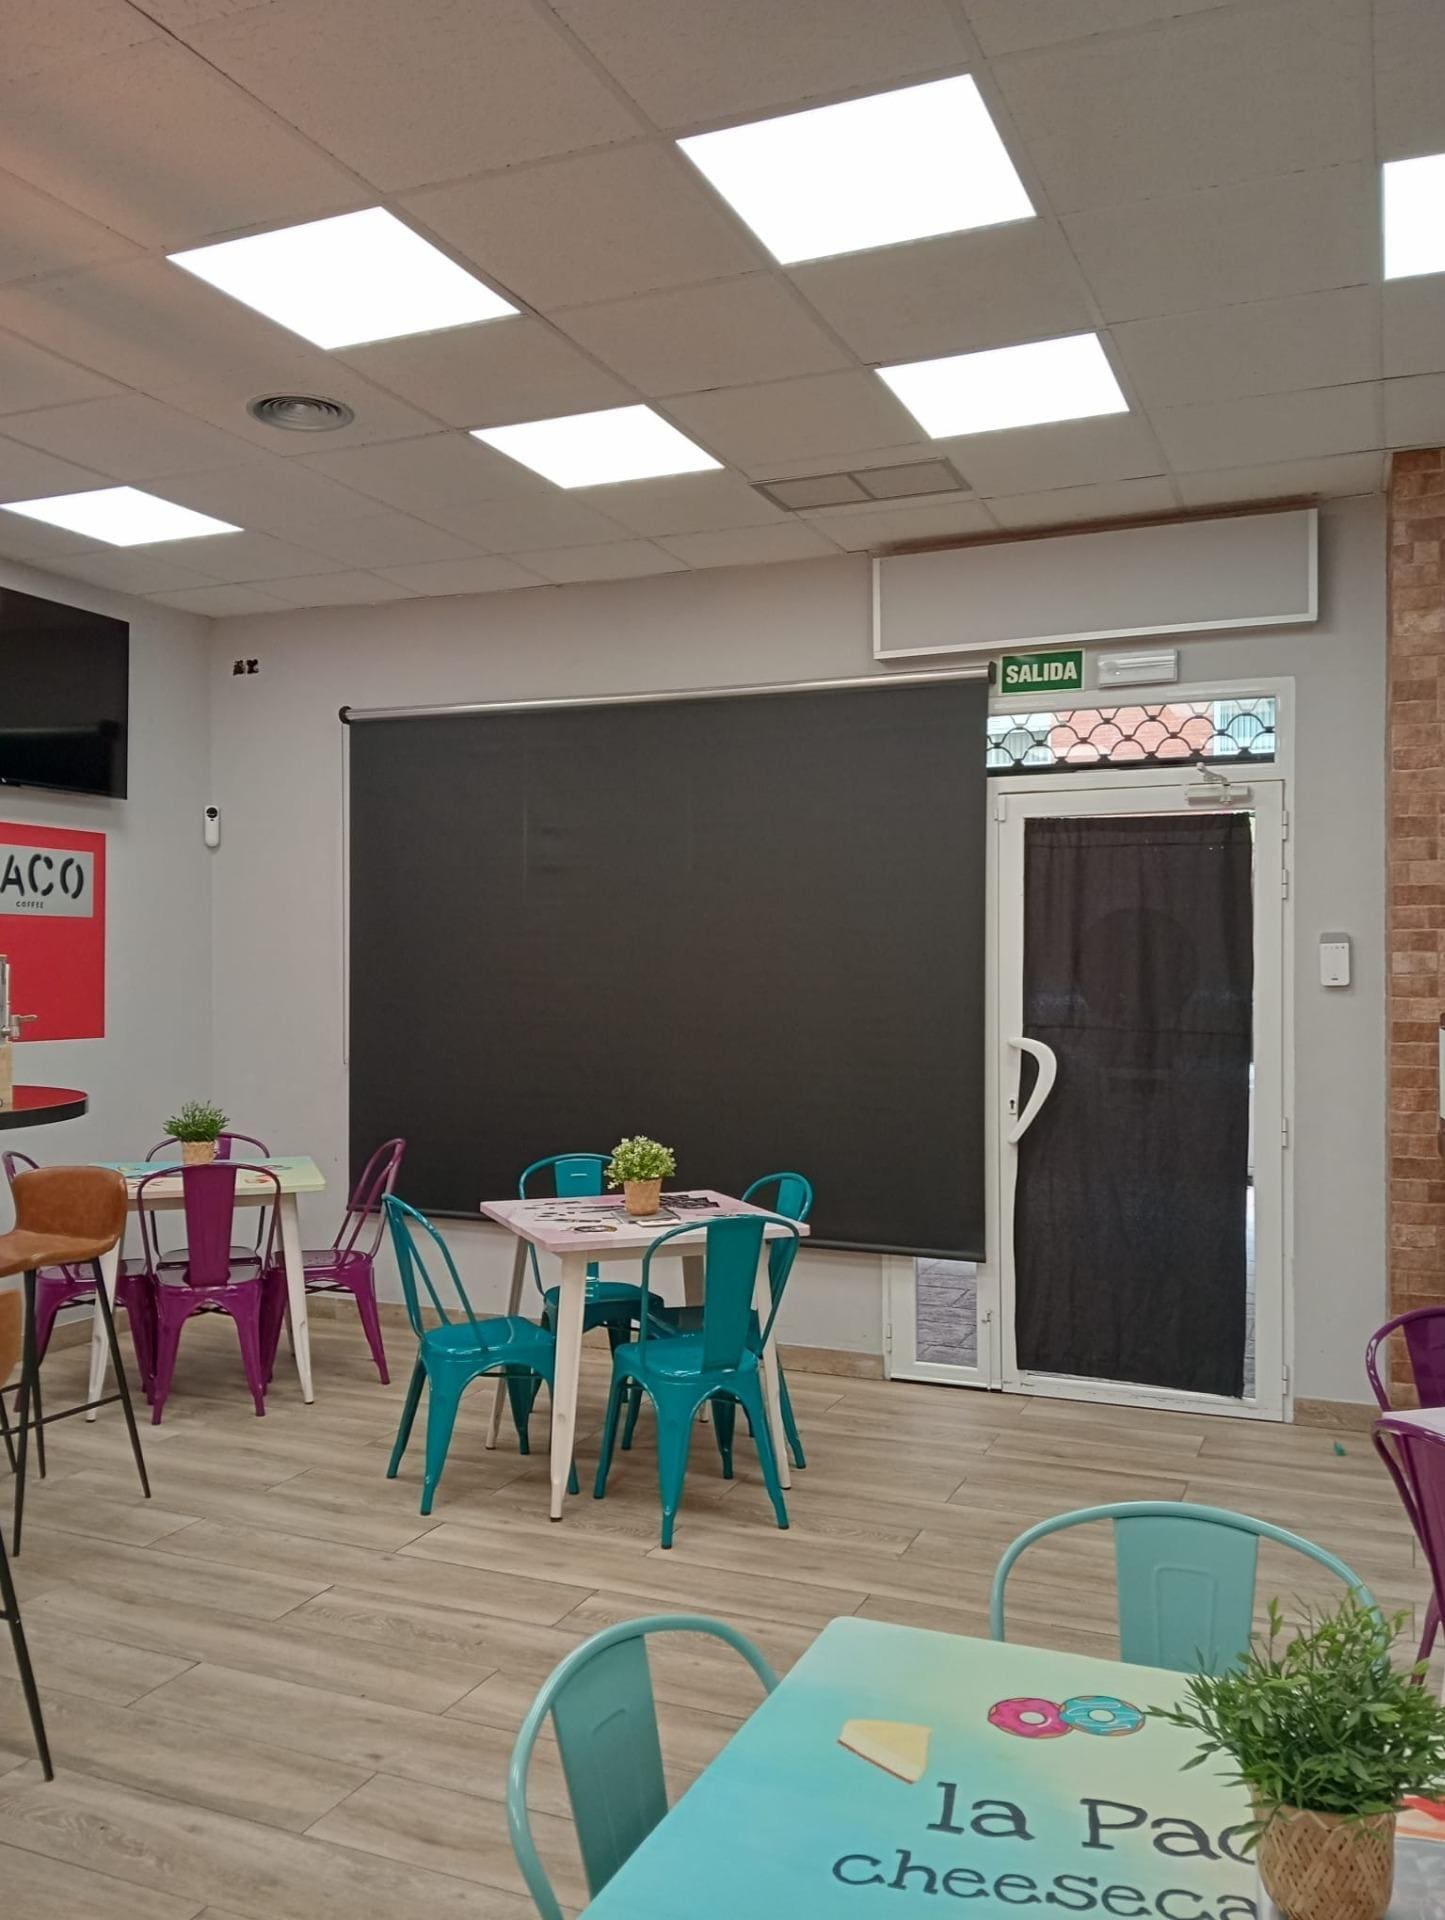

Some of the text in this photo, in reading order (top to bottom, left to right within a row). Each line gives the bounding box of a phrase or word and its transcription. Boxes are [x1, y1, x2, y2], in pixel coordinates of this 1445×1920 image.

[1005, 661, 1078, 684] SALIDA
[15, 901, 44, 909] COFFEE
[926, 1781, 1035, 1841] la
